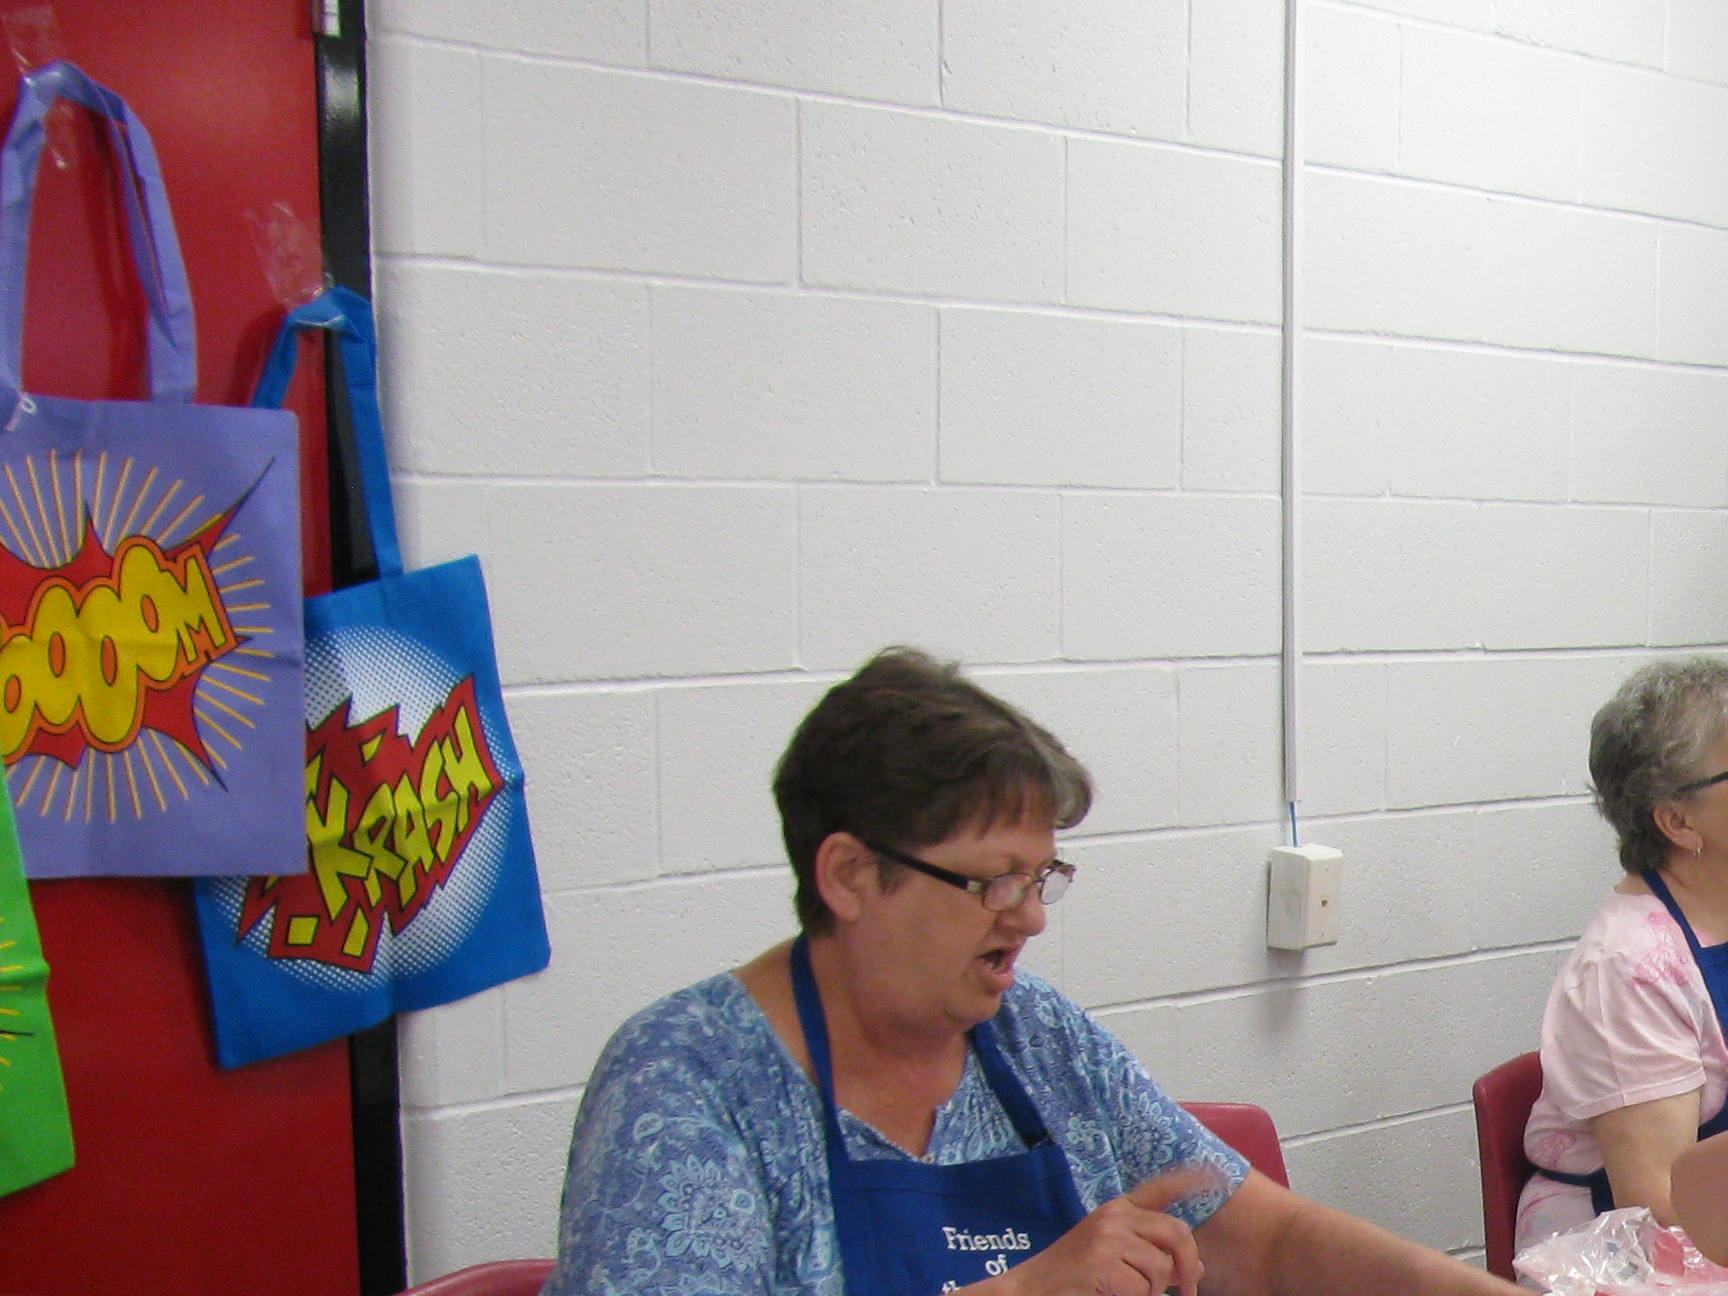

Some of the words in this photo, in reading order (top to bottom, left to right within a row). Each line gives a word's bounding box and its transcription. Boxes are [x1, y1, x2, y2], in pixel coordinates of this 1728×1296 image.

[0, 543, 228, 757] OOOOM
[942, 1226, 1031, 1251] Friends
[985, 1253, 1009, 1276] of
